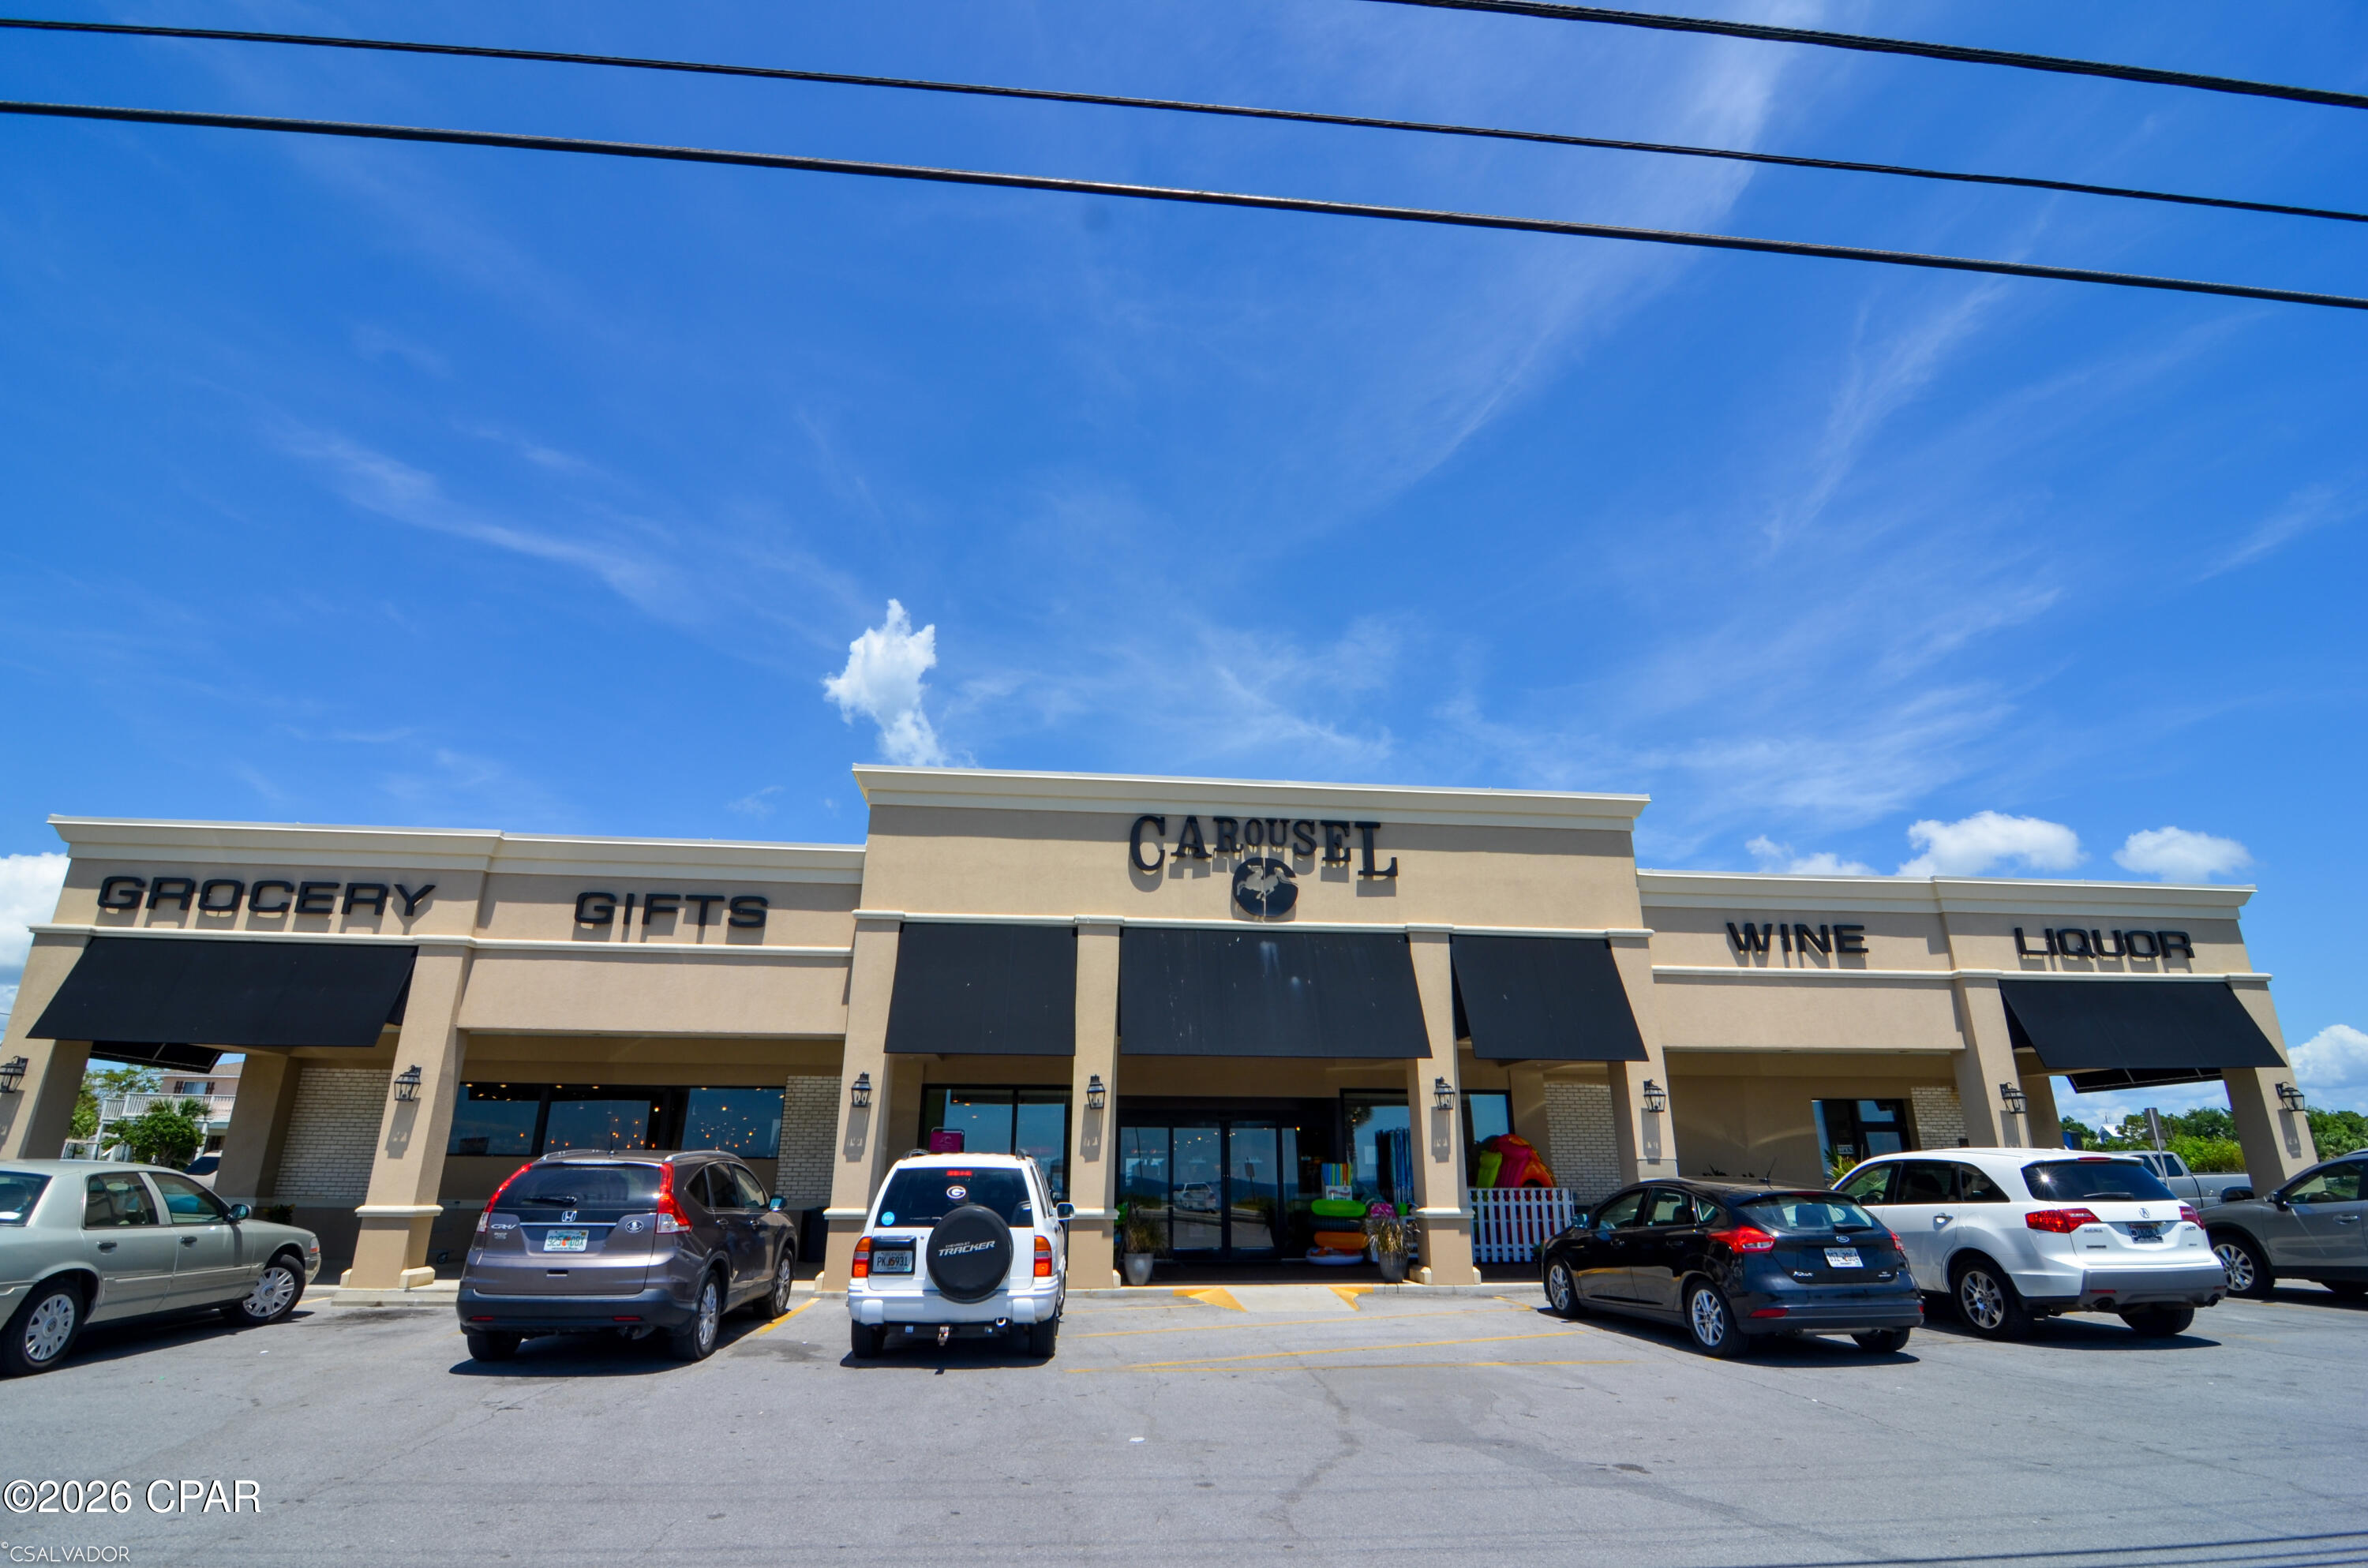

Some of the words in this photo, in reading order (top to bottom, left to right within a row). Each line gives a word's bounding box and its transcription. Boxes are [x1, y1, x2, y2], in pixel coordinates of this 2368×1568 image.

[1130, 815, 1398, 877] CAROUSEL
[97, 876, 436, 916] GROCERY
[575, 892, 769, 928] GIFTS
[1726, 922, 1869, 953] WINE
[2014, 927, 2195, 959] LIQUOR
[939, 1241, 995, 1256] TRACKER
